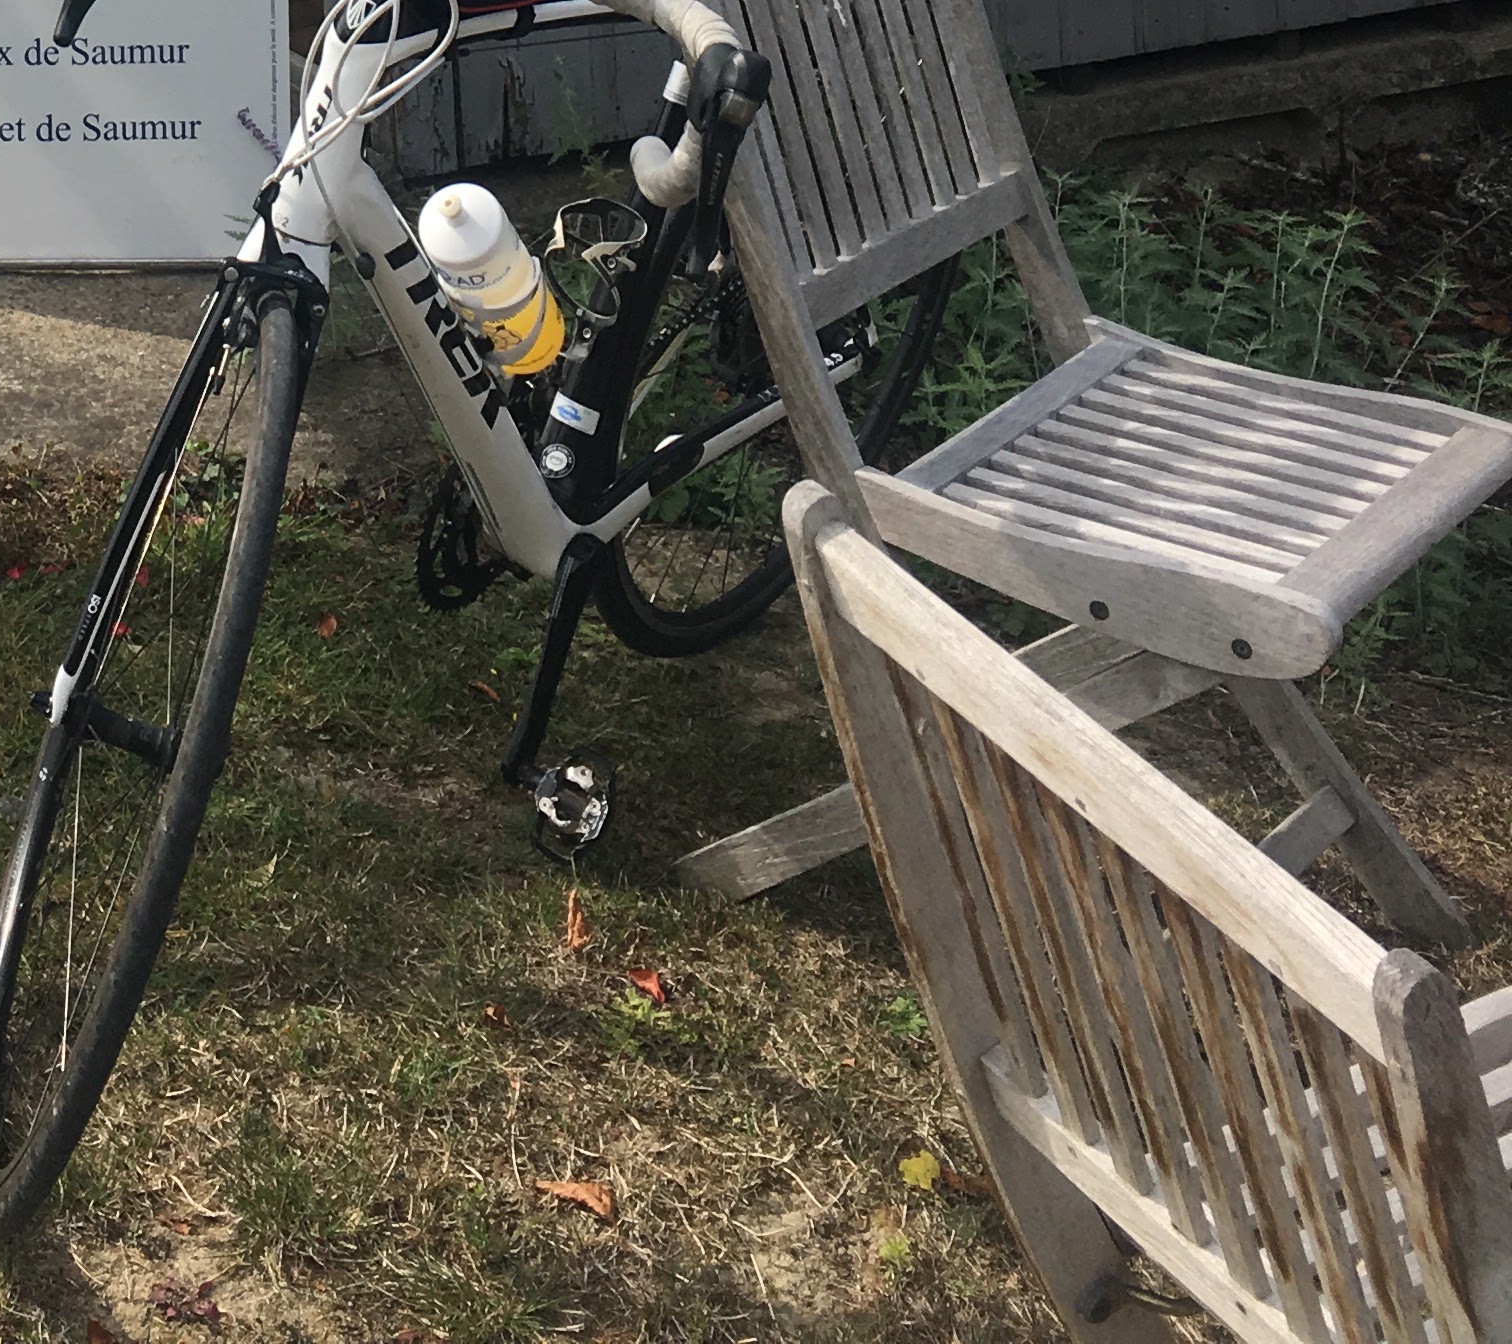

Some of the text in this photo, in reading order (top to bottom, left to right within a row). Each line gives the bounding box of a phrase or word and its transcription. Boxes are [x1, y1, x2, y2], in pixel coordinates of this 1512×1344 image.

[24, 38, 60, 66] de
[70, 38, 190, 66] Saumur
[36, 114, 72, 141] de
[82, 114, 202, 141] Saumur
[384, 237, 508, 431] TREK
